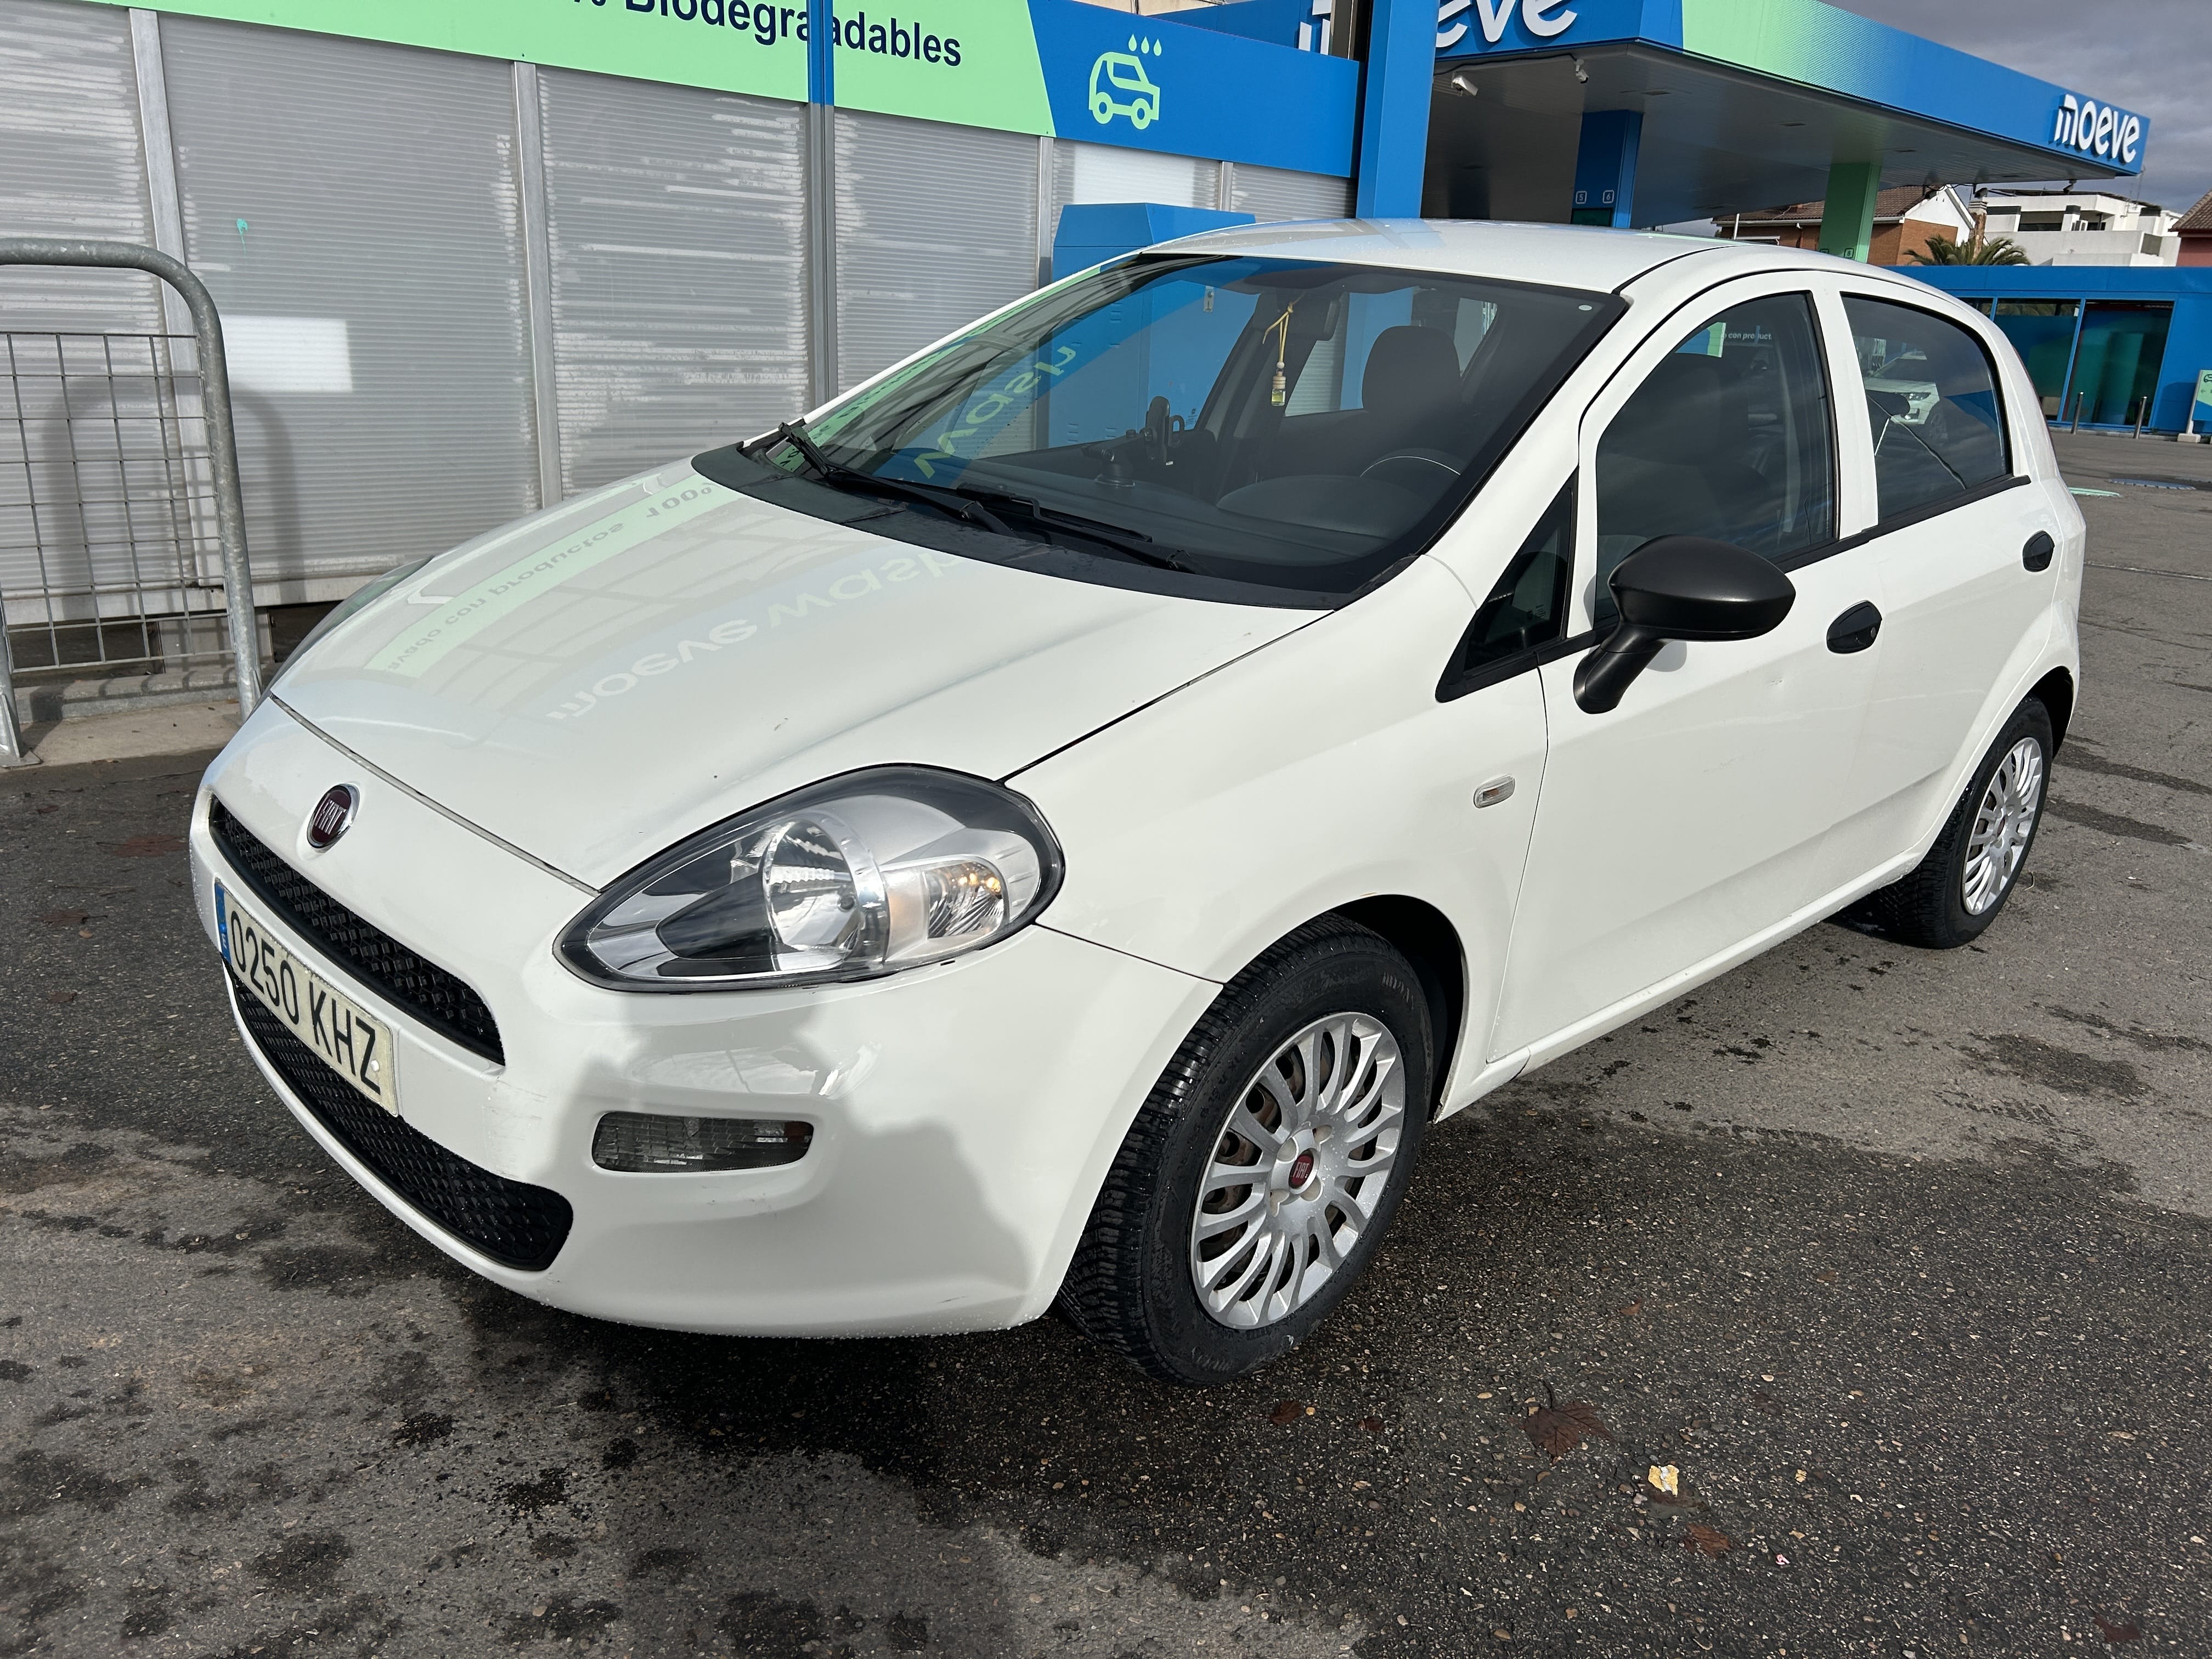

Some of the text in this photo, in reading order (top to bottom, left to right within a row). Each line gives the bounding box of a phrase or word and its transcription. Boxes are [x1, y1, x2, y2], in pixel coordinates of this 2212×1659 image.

[2054, 94, 2140, 162] moeve
[314, 798, 347, 836] FIAT
[231, 911, 381, 1096] 0250 KHZ
[1293, 1161, 1310, 1179] FIAT
